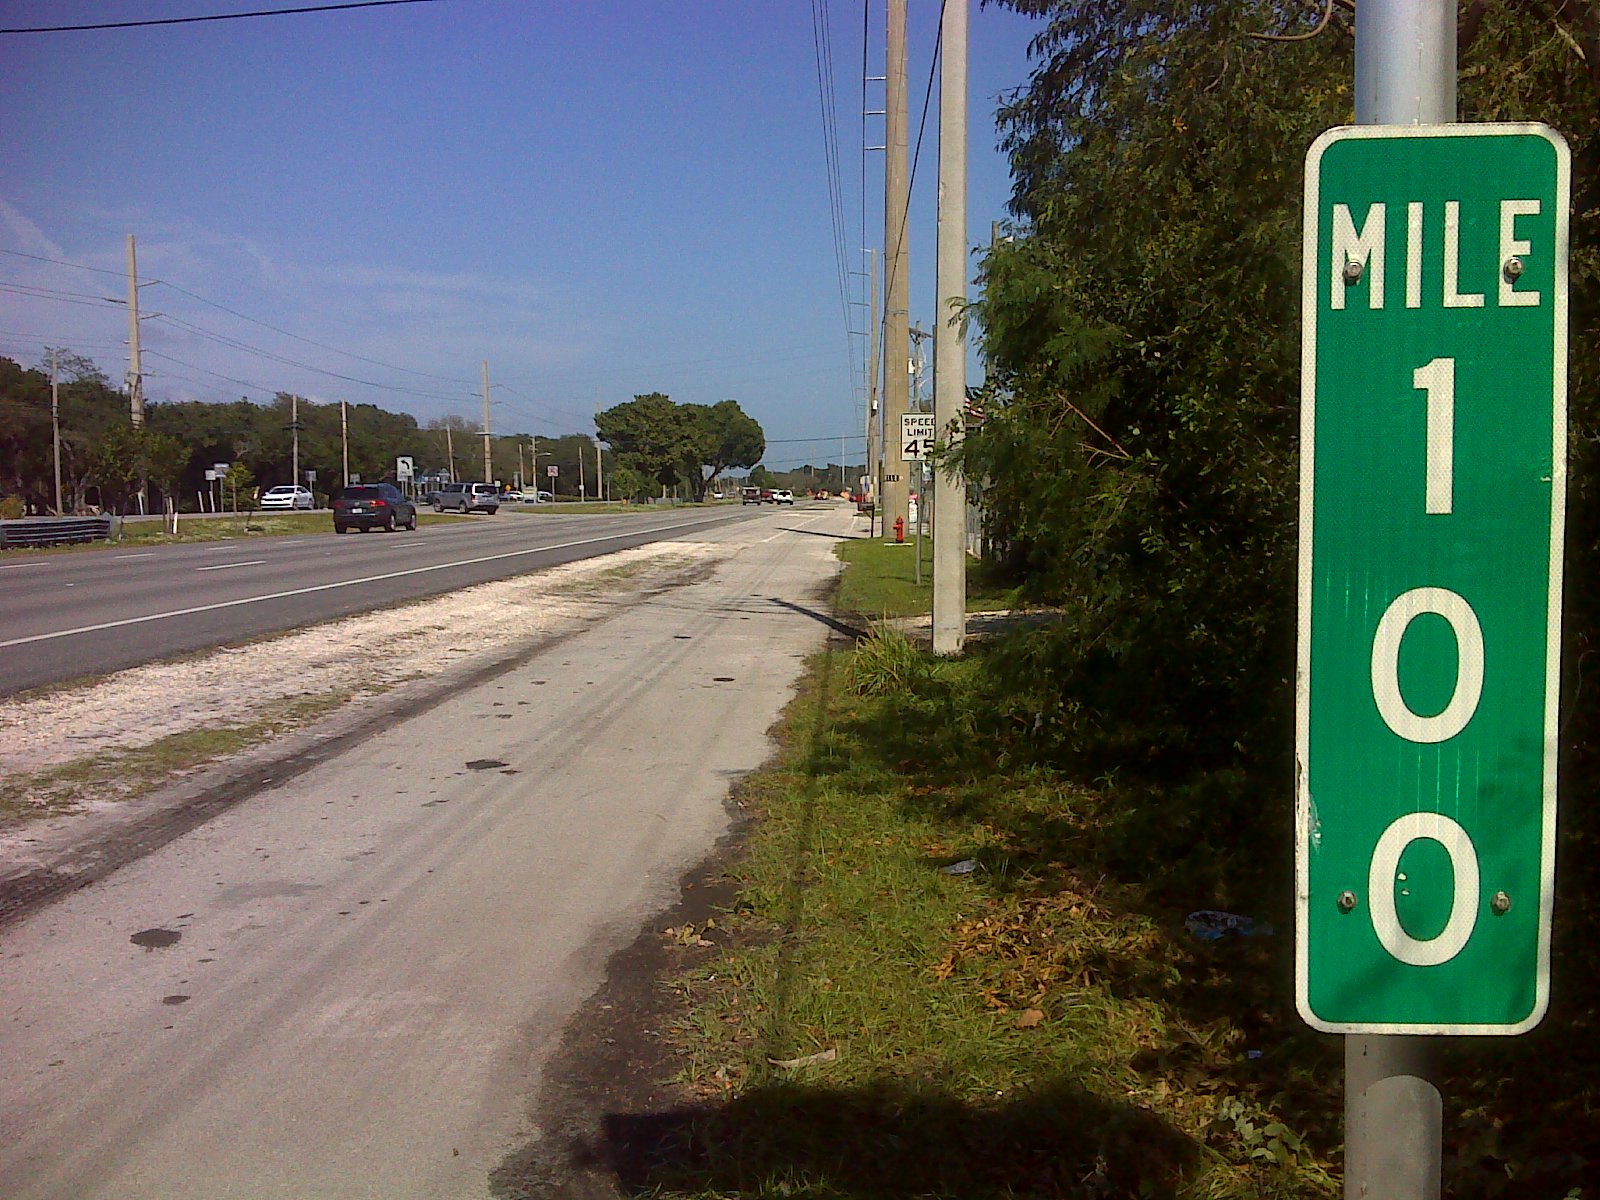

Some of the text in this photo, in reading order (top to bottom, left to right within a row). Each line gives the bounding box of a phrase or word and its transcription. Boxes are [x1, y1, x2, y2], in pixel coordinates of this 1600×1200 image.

[1330, 199, 1541, 310] MILE
[907, 428, 933, 437] LIMIT
[904, 439, 936, 459] 45
